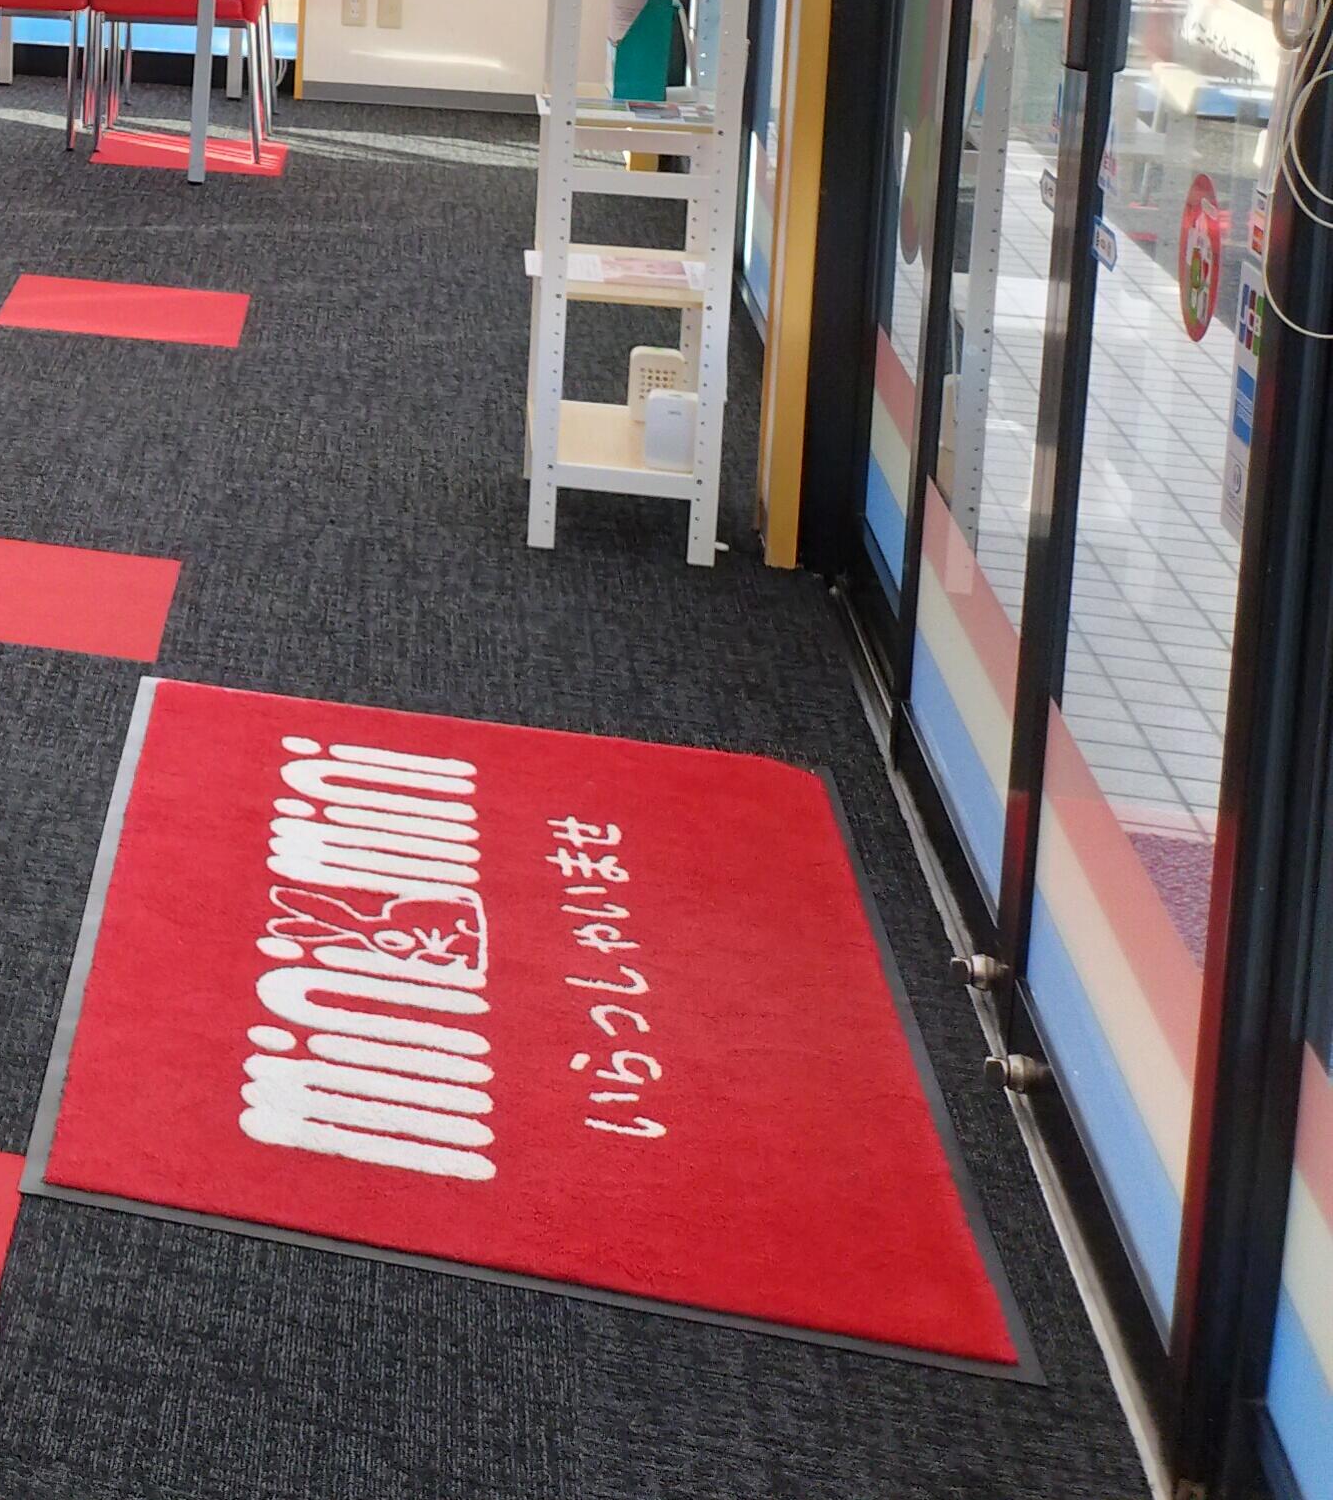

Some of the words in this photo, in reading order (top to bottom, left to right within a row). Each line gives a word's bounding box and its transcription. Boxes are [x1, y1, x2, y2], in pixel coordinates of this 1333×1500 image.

[544, 814, 668, 1140] いらっしゃいませ
